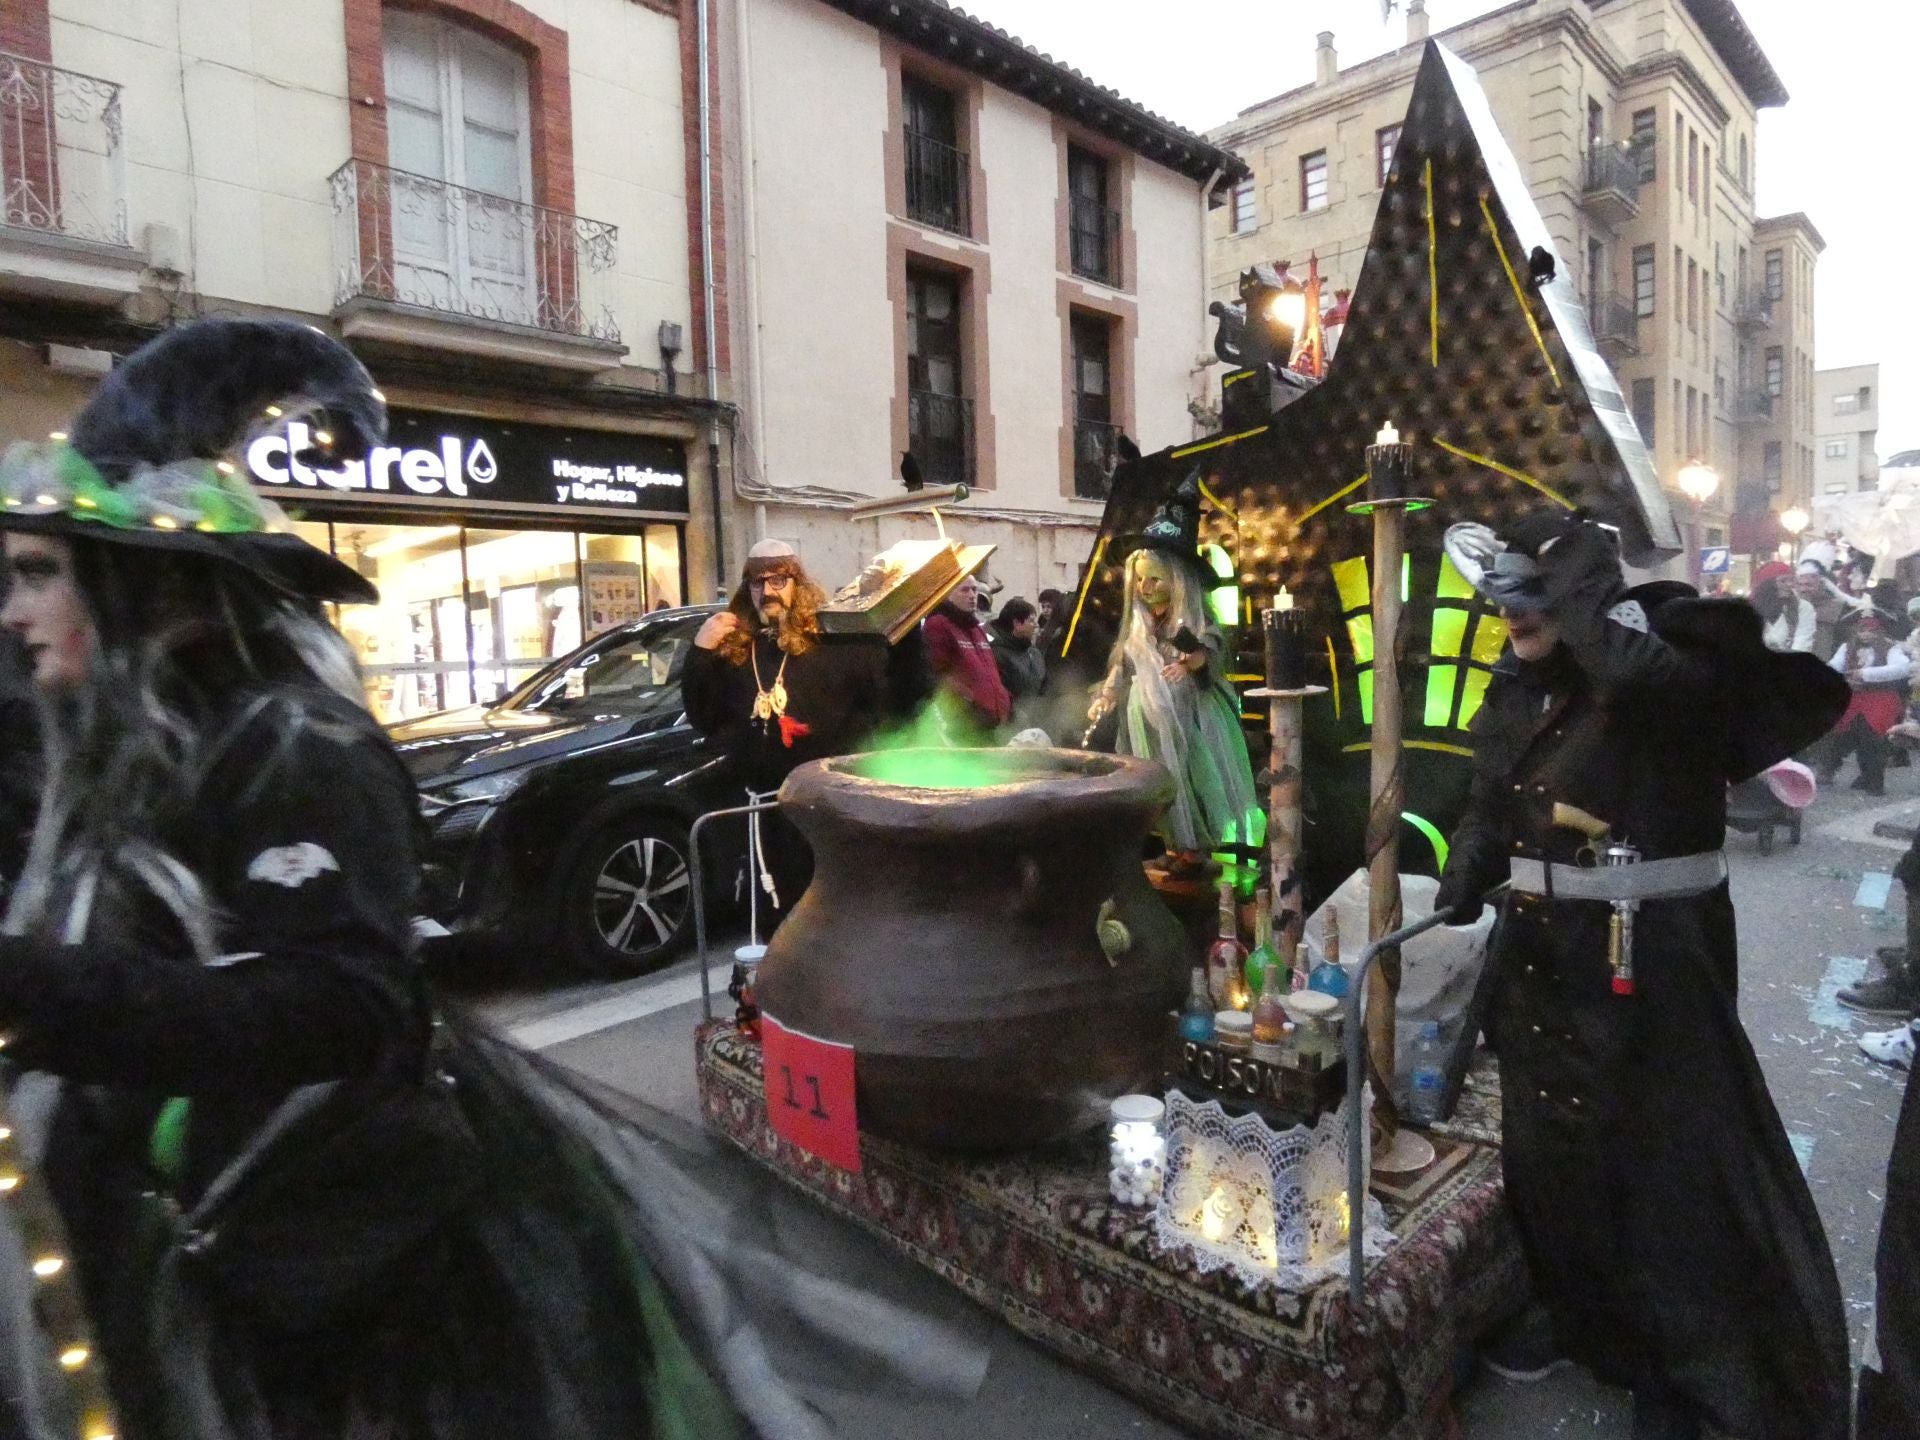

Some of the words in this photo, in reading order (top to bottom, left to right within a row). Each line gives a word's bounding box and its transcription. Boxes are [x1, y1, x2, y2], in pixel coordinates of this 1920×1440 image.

[553, 459, 614, 483] Hogar,
[617, 465, 683, 488] Higiene
[556, 485, 569, 502] y
[572, 482, 637, 503] Belleza
[1184, 1042, 1283, 1100] POISON
[781, 1065, 830, 1121] 11
